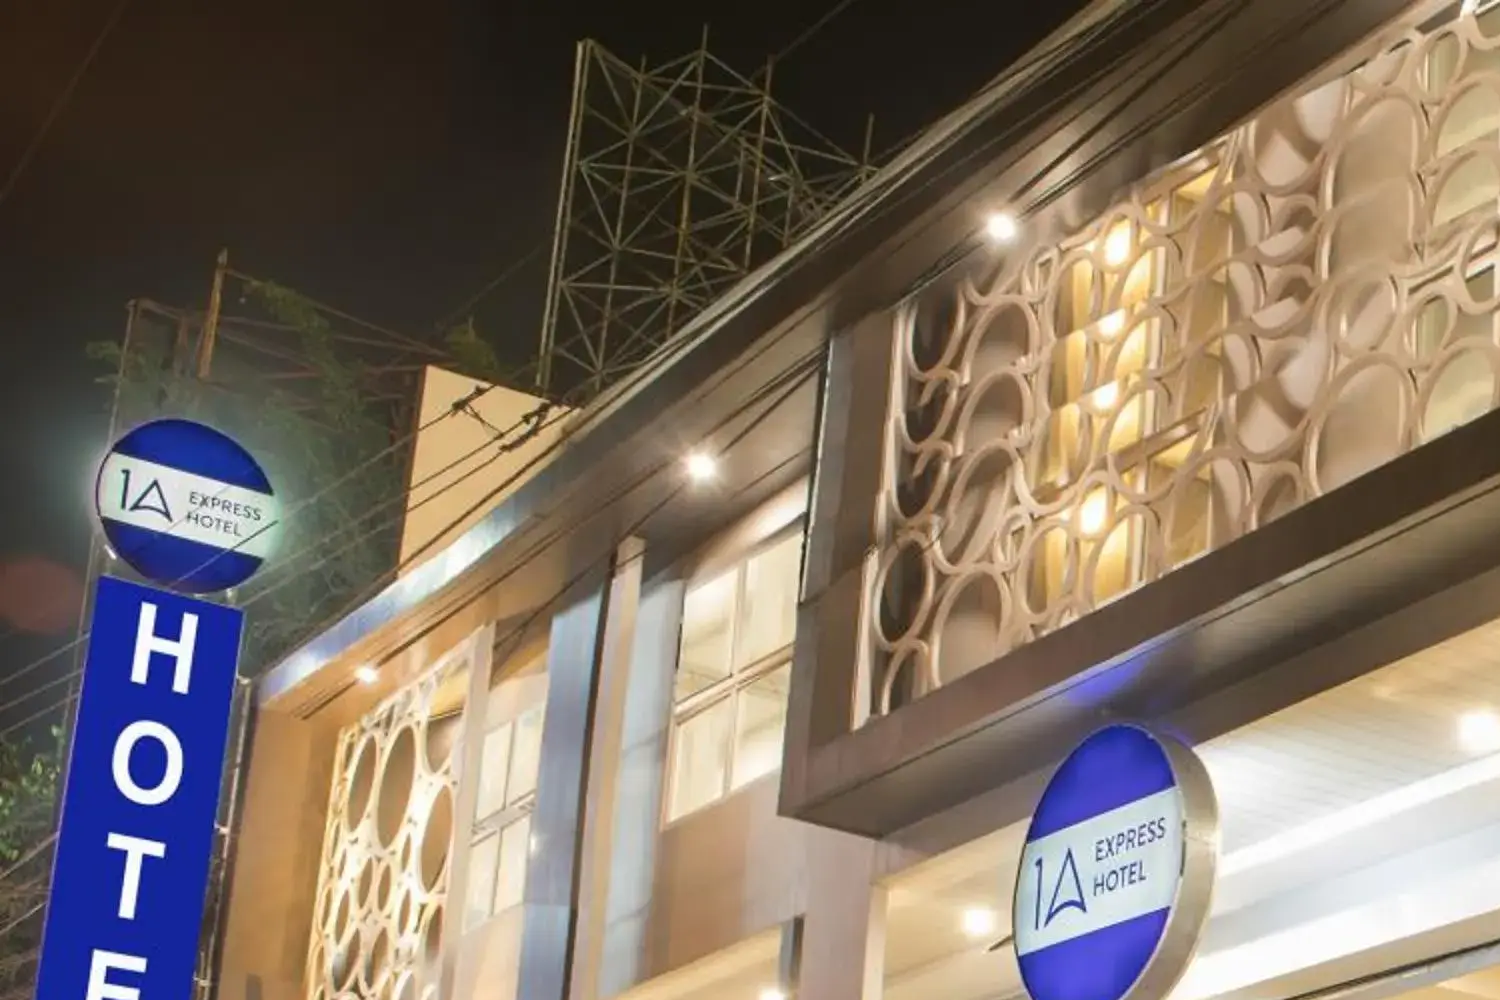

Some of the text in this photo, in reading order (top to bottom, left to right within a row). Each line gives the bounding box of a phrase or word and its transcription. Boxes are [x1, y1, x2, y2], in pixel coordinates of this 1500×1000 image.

[188, 491, 262, 522] EXPRESS
[186, 510, 243, 537] HOTEL
[1095, 817, 1167, 862] EXPRESS
[1093, 862, 1148, 898] HOTEL
